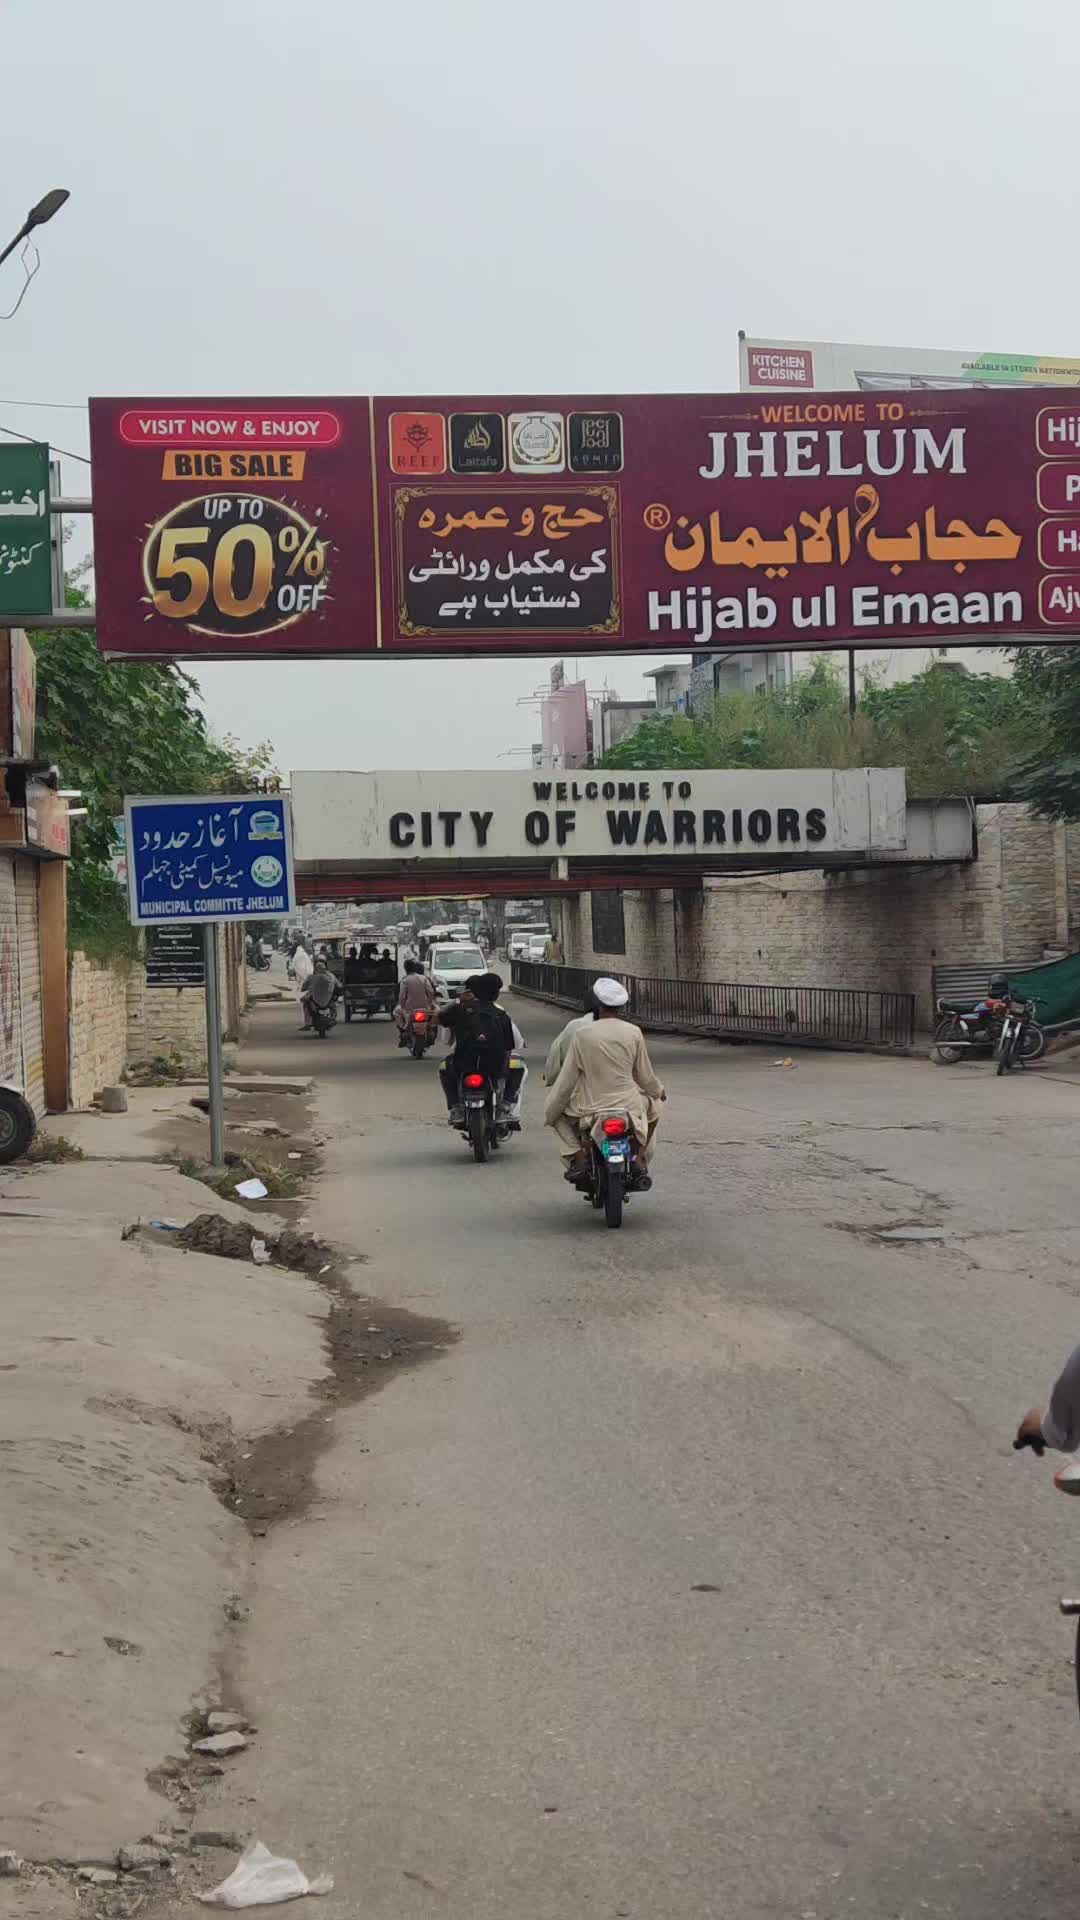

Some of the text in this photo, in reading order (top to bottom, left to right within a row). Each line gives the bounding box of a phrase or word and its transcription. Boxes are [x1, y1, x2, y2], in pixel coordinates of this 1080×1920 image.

[752, 354, 805, 369] KITCHEN
[758, 367, 806, 381] CUISINE
[139, 419, 320, 436] VISIT NOW & ENJOY
[761, 403, 904, 423] WELCOME TO
[174, 453, 294, 478] BIG SALE
[699, 427, 968, 479] JHELUM
[203, 498, 264, 520] UP TO
[418, 504, 605, 539] حج و عمرہ
[867, 504, 1024, 576] حجاب
[153, 523, 325, 618] 50%
[494, 548, 565, 580] مکمل
[569, 548, 607, 581] کی
[277, 584, 328, 612] OFF
[438, 584, 581, 620] دستیاب ہے
[648, 585, 1023, 642] Hijab ul Emaan
[533, 781, 692, 801] WELCOME TO
[139, 804, 244, 851] آغاز حدود
[388, 808, 828, 848] CITY OF WARRIORS
[140, 895, 284, 915] MUNICIPAL COMMITTE JHELUM
